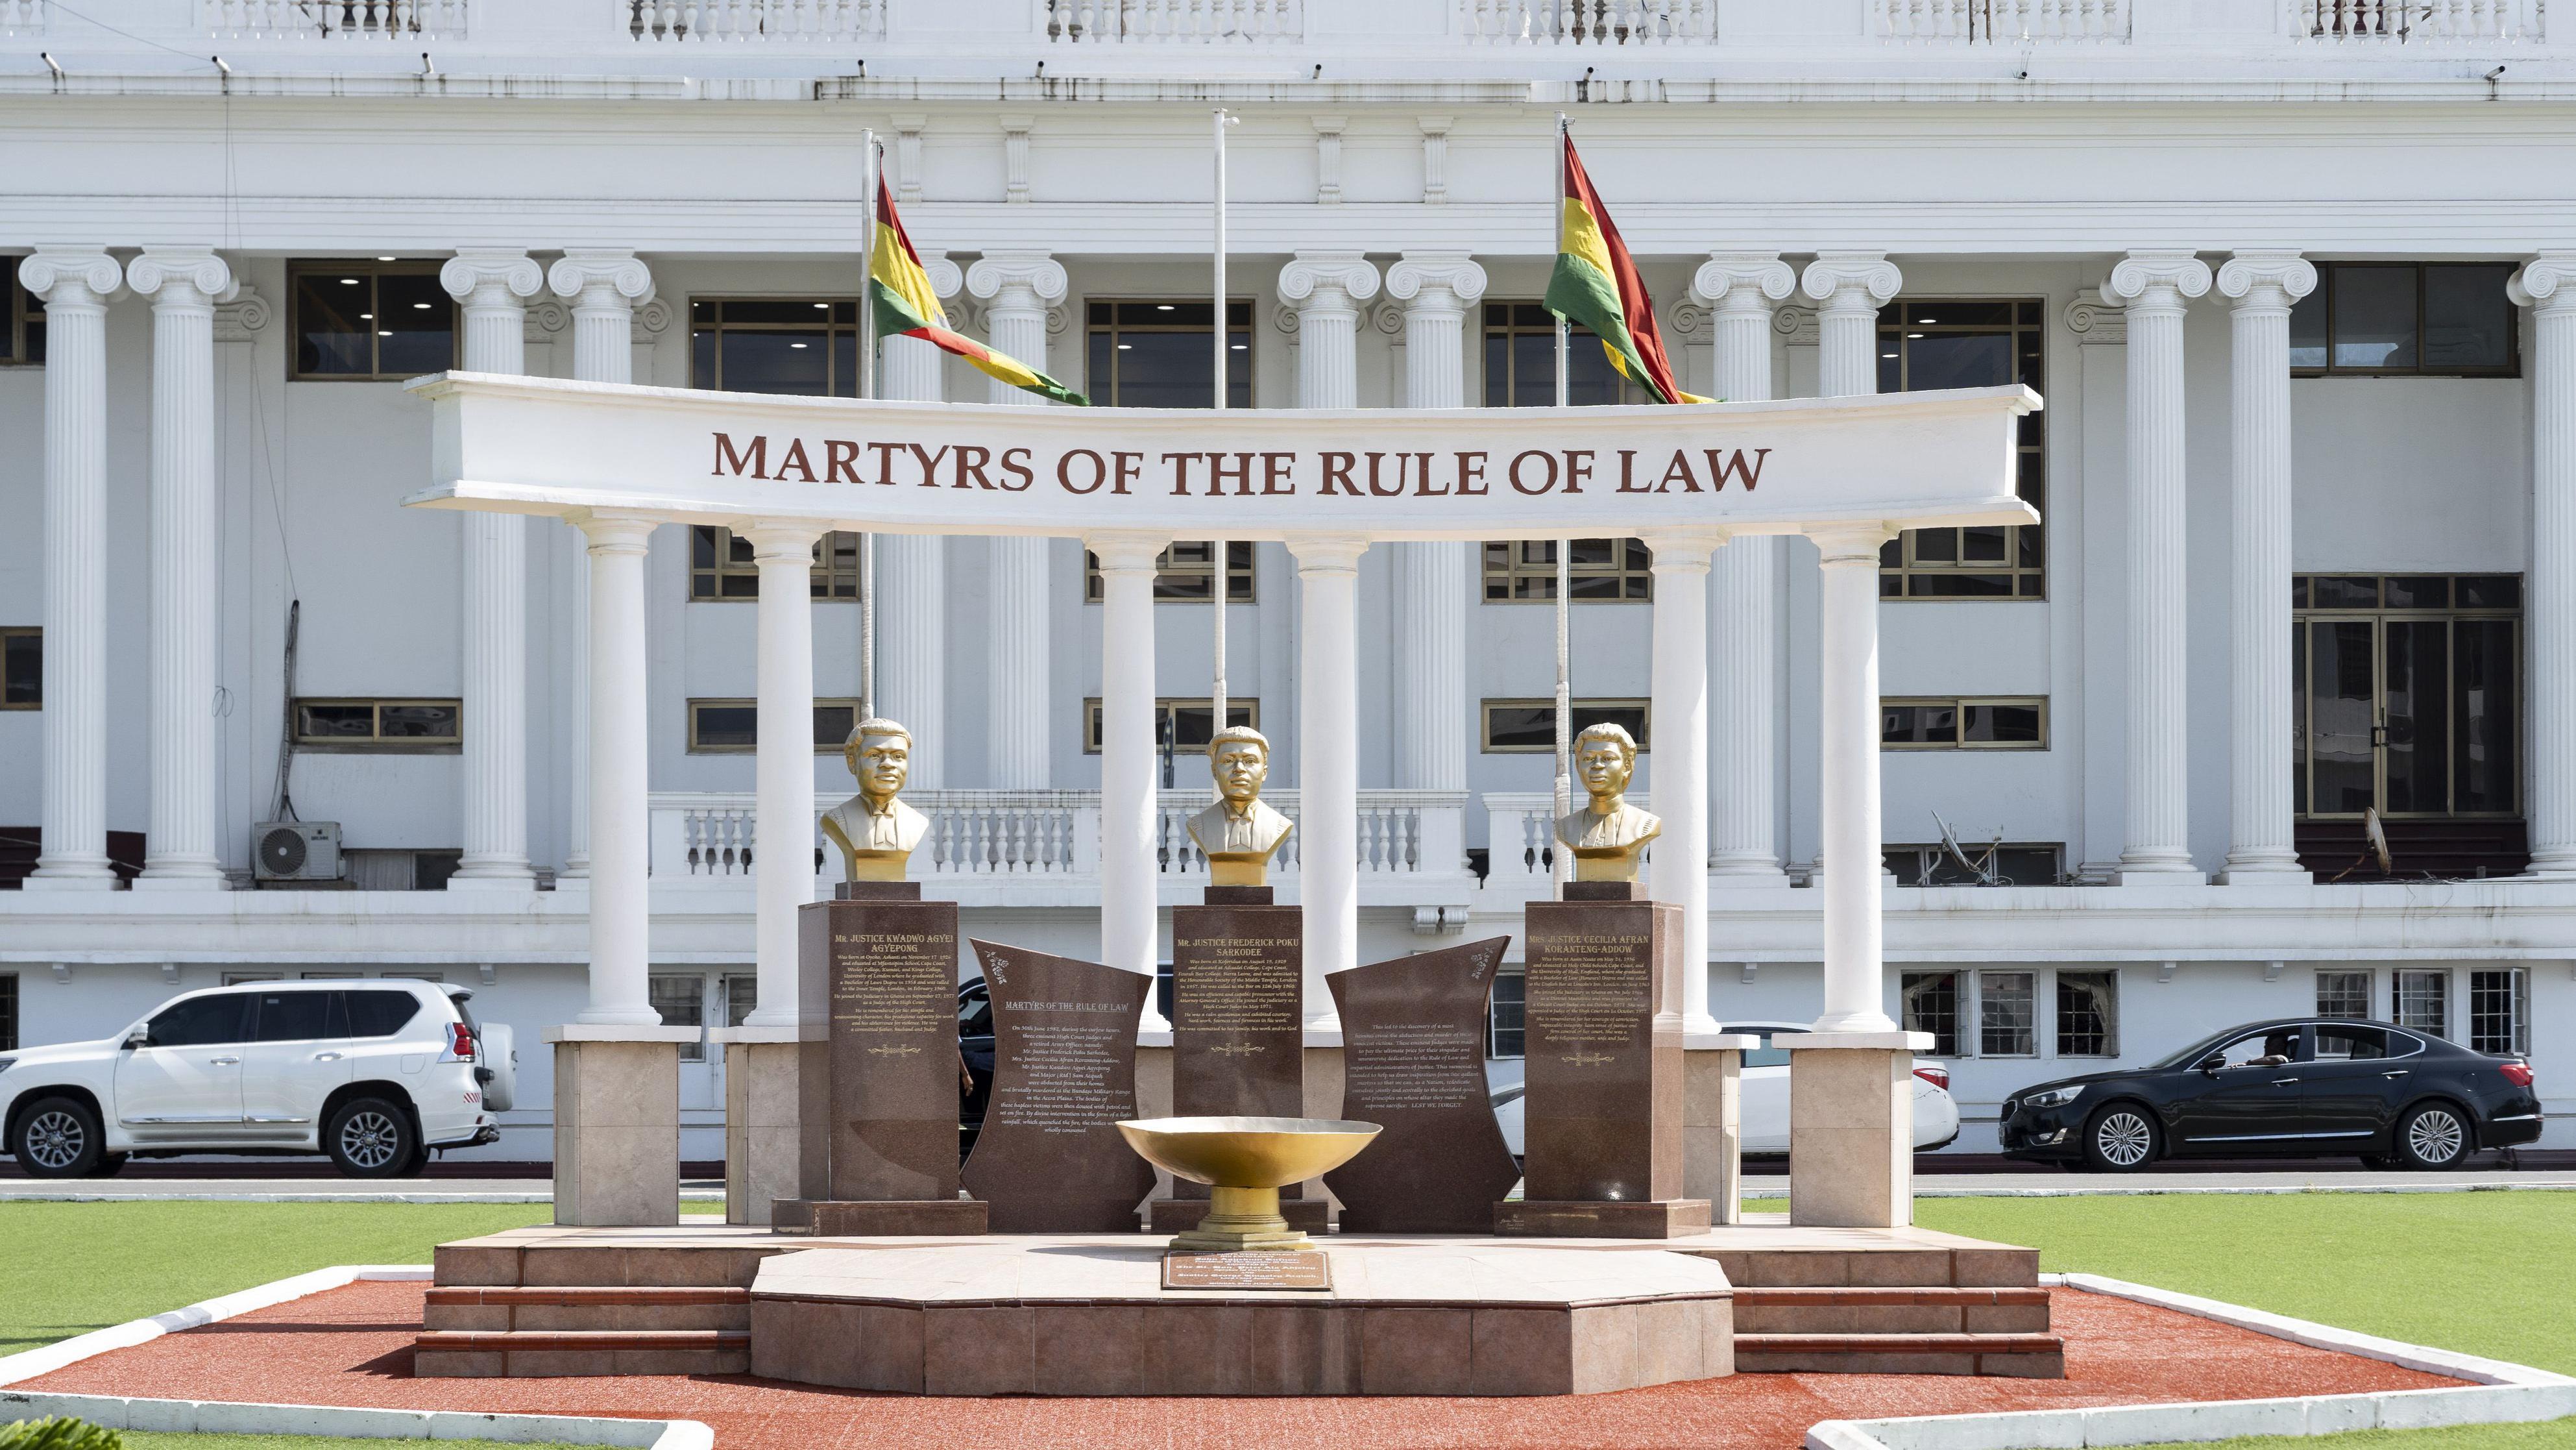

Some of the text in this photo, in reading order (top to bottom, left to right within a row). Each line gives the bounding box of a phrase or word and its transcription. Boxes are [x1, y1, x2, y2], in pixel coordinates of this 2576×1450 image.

[712, 432, 1772, 496] MARTYRS OF THE RULE OF LAW
[886, 934, 925, 942] KWADWO
[927, 934, 953, 942] AGYEI
[871, 944, 918, 952] AGYEPONG
[1005, 1001, 1045, 1009] MARTYRS
